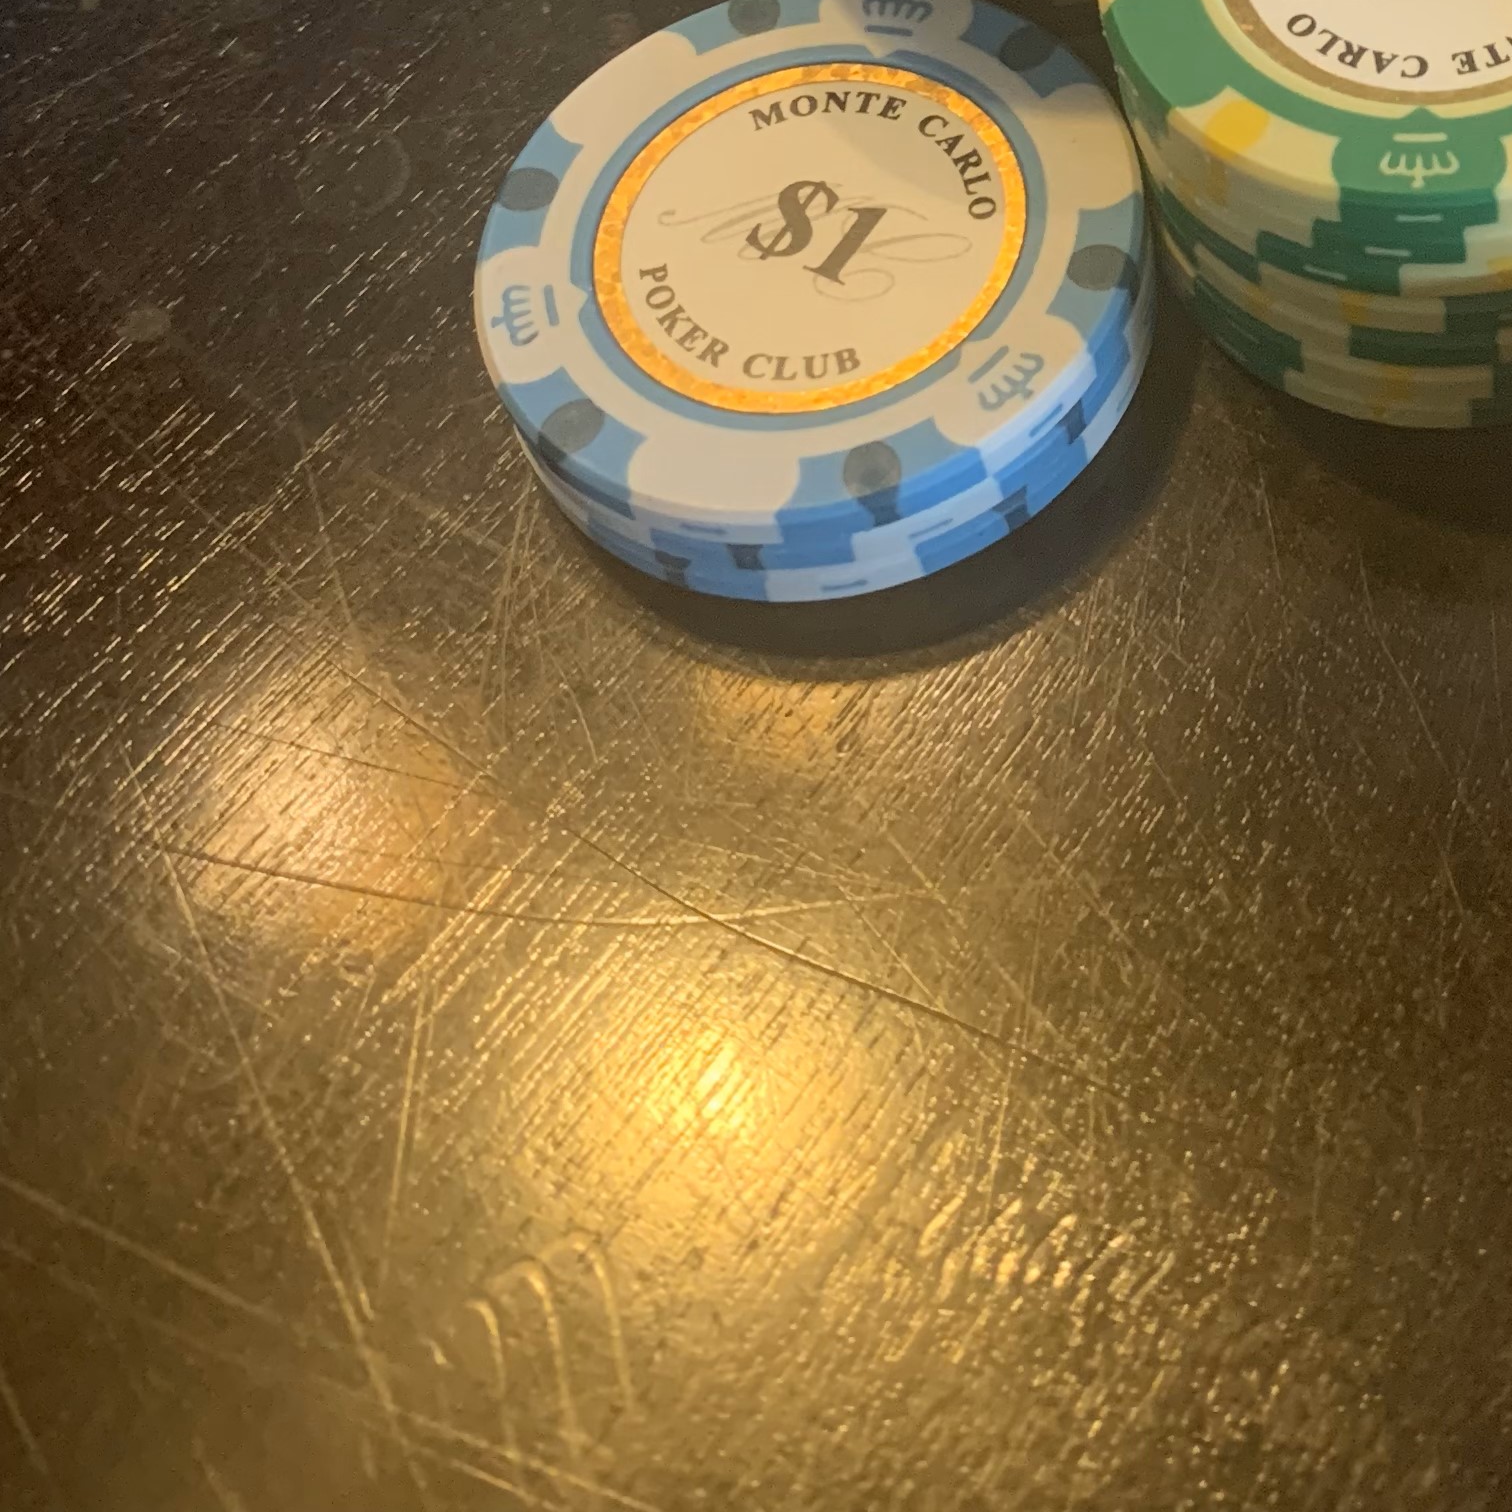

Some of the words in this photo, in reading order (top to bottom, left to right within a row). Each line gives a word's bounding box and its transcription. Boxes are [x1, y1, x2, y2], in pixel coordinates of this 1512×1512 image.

[1286, 13, 1429, 78] CARLO
[748, 91, 908, 131] MONTE
[917, 114, 996, 220] CARLO
[745, 180, 887, 286] $1
[639, 263, 729, 368] POKER
[742, 347, 861, 381] CLUB
